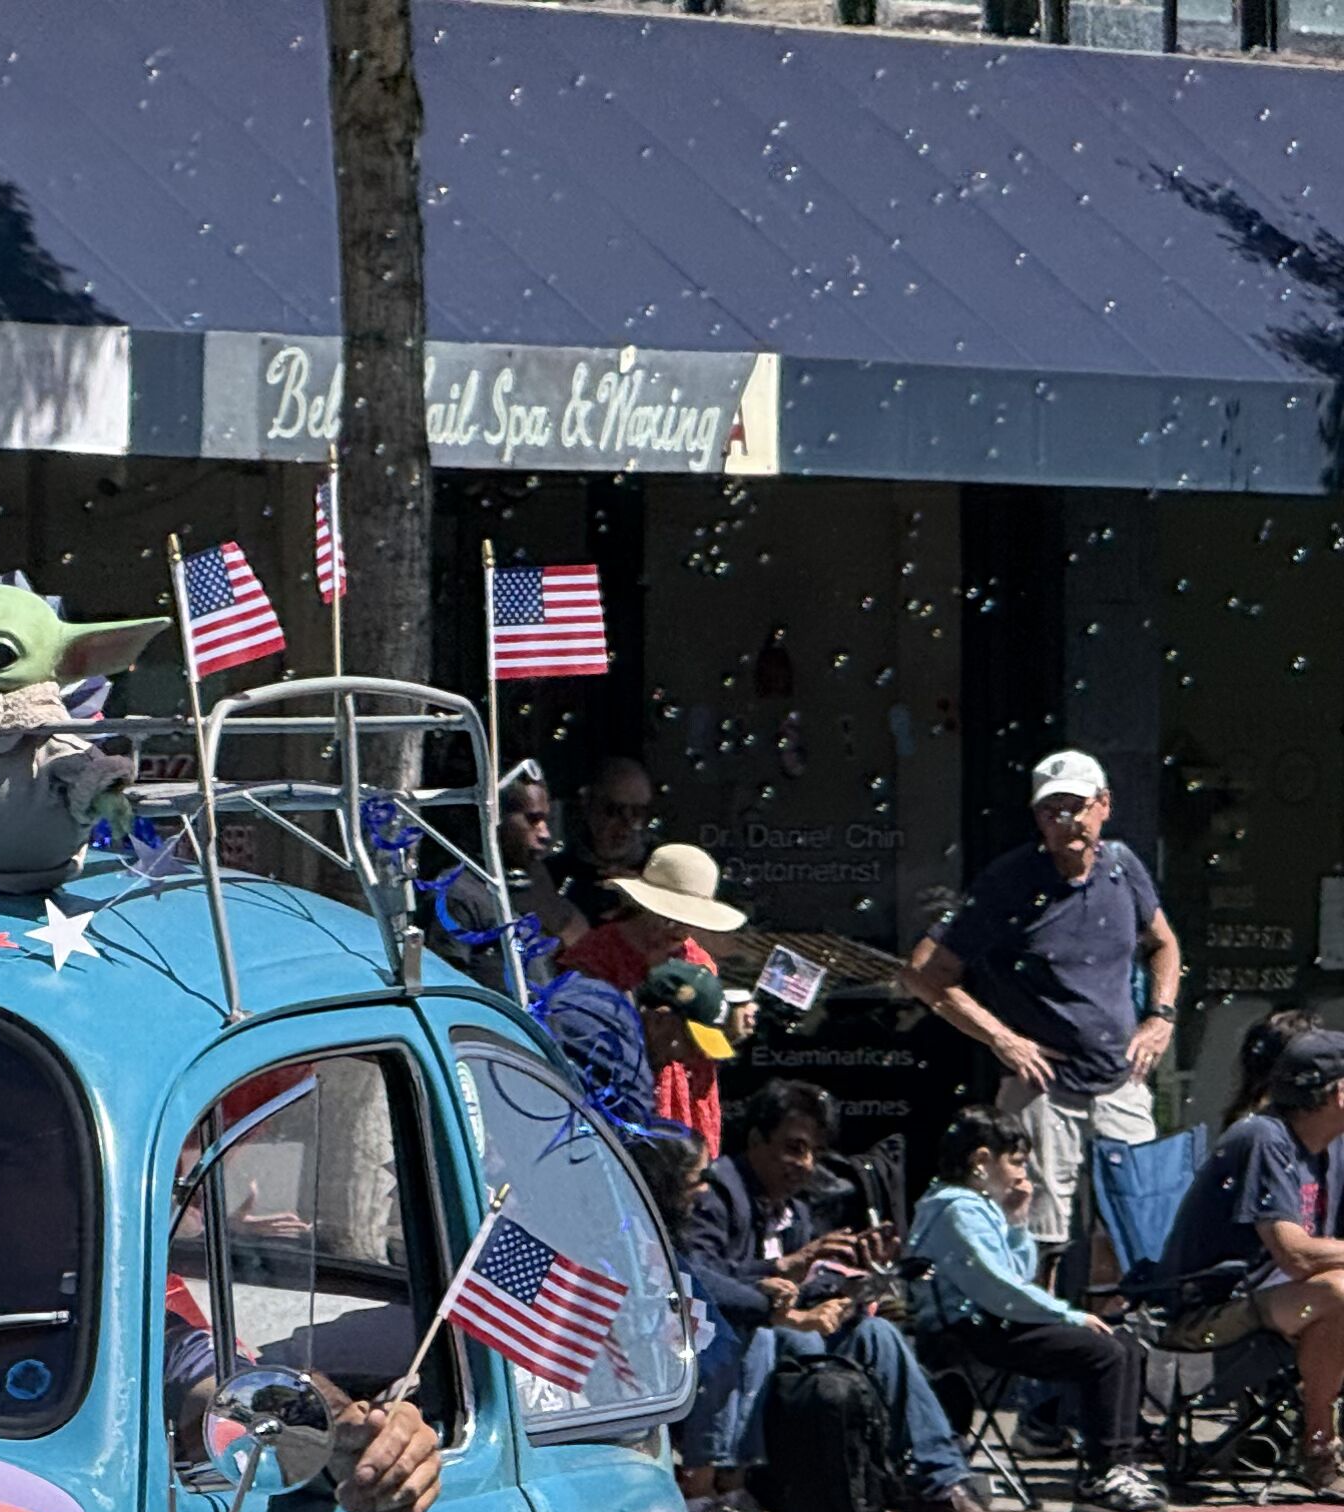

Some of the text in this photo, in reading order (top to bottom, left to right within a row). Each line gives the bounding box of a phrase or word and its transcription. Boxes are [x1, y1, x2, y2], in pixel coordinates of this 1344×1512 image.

[267, 346, 345, 439] Bel
[484, 368, 551, 463] Spa
[562, 362, 594, 447] &
[597, 368, 721, 472] Waxing
[748, 824, 832, 848] Daniel
[845, 824, 905, 848] Chin
[726, 857, 880, 883] Optometrist
[751, 1045, 915, 1067] Examinations
[838, 1099, 912, 1117] rames
